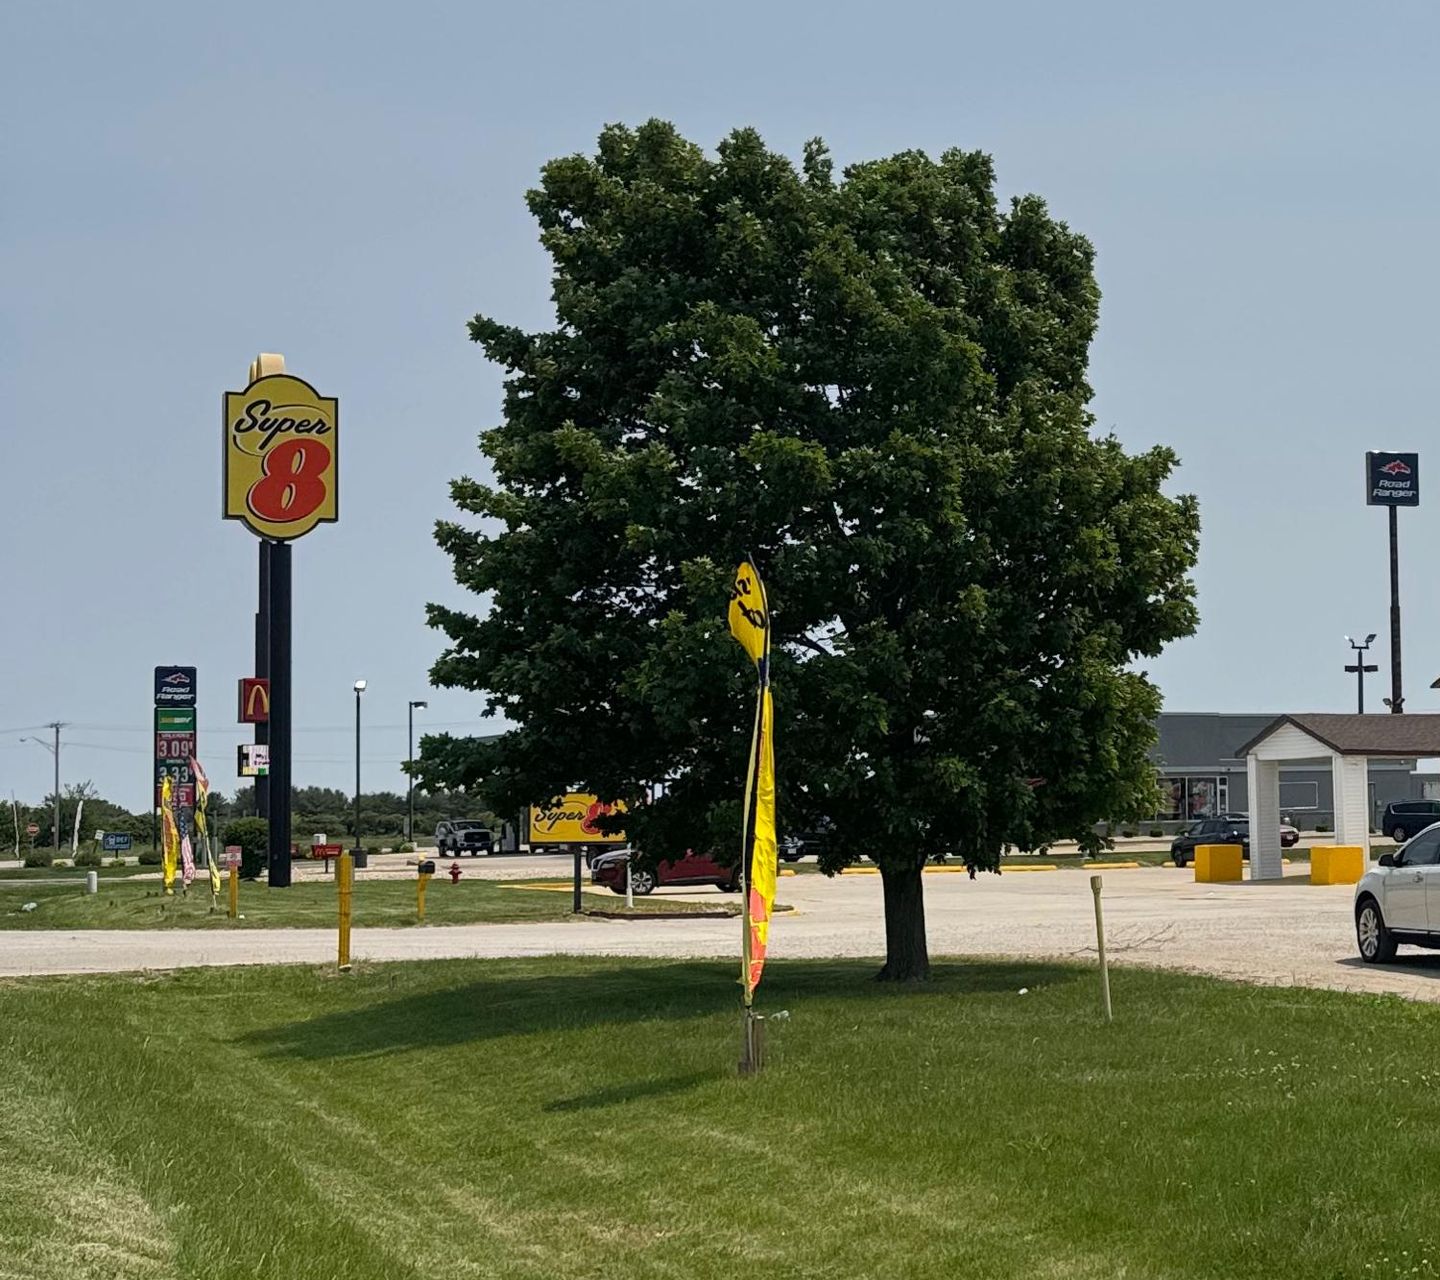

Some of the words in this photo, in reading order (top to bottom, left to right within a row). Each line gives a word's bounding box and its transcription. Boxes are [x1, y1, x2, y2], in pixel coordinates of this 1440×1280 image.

[233, 399, 332, 451] Super
[246, 437, 331, 523] 8
[1379, 480, 1411, 488] Road
[1373, 488, 1417, 497] Ranger
[535, 810, 585, 831] Super
